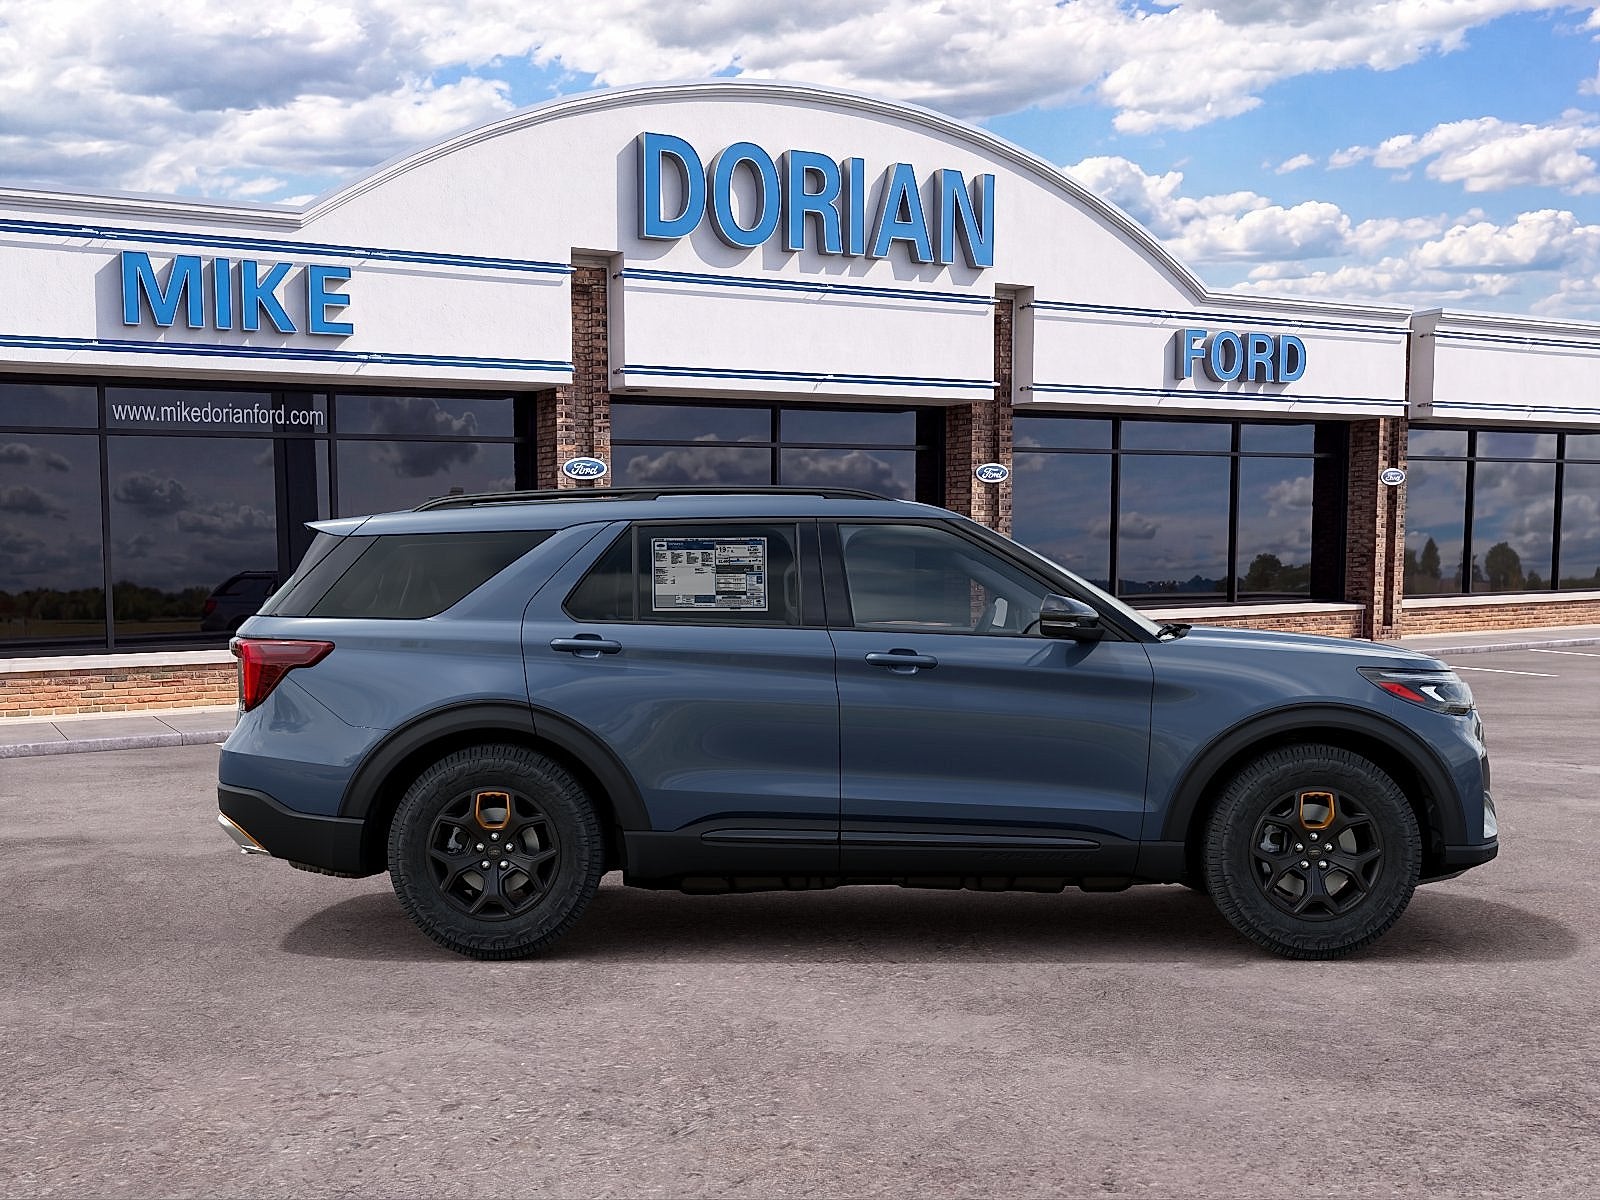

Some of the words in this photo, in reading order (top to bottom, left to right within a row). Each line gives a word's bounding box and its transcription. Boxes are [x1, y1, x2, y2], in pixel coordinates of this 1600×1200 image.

[640, 131, 996, 269] DORIAN
[121, 250, 354, 337] MIKE
[1180, 328, 1307, 383] FORD
[112, 401, 325, 426] www.mikedorianford.com
